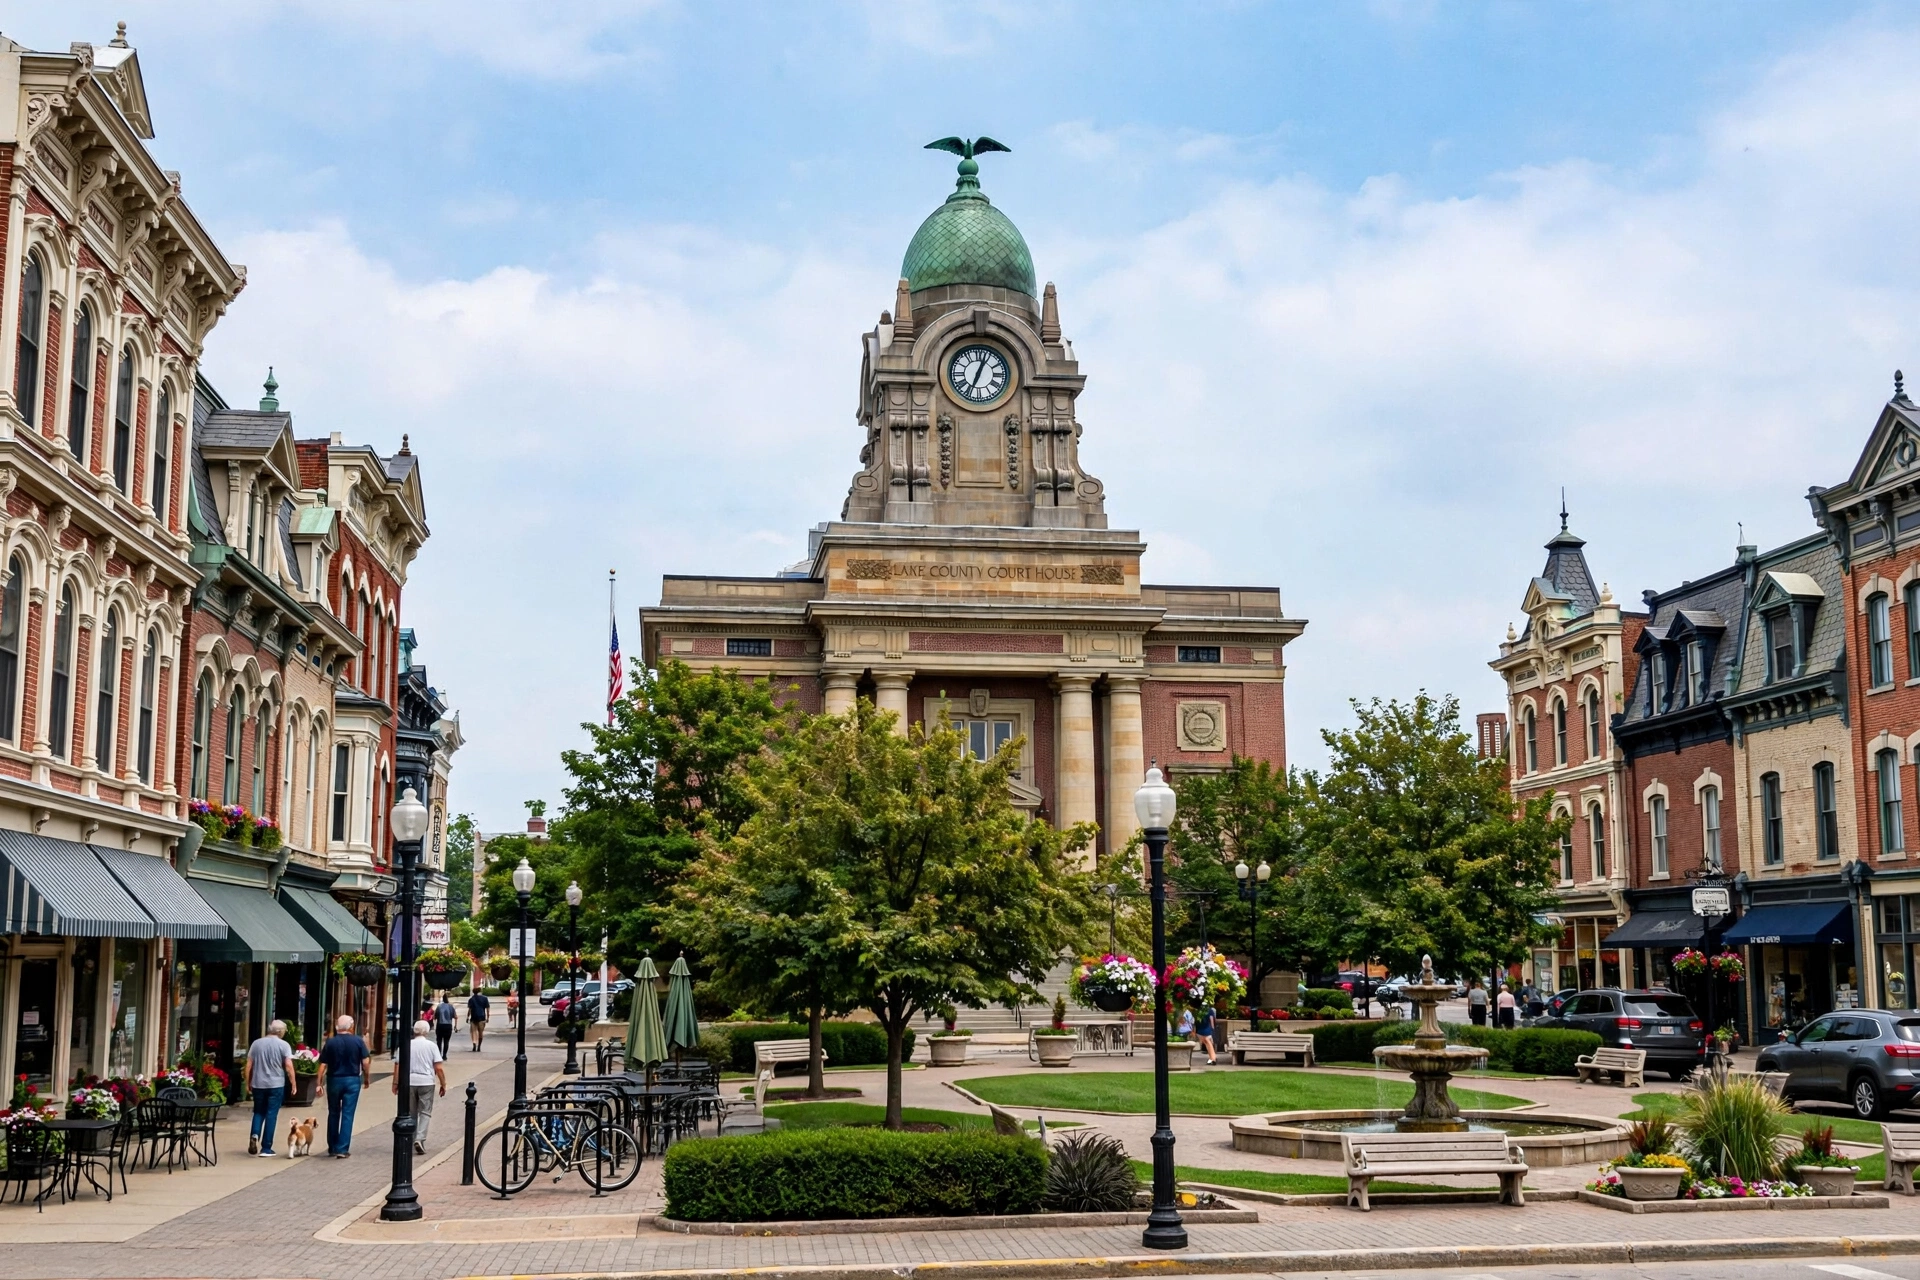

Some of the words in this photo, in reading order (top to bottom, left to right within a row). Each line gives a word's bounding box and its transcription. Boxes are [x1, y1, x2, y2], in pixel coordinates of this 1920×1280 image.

[893, 564, 926, 577] LAKE
[929, 565, 983, 579] COUNTY
[987, 566, 1032, 579] COURT
[1035, 566, 1076, 580] HOUSE
